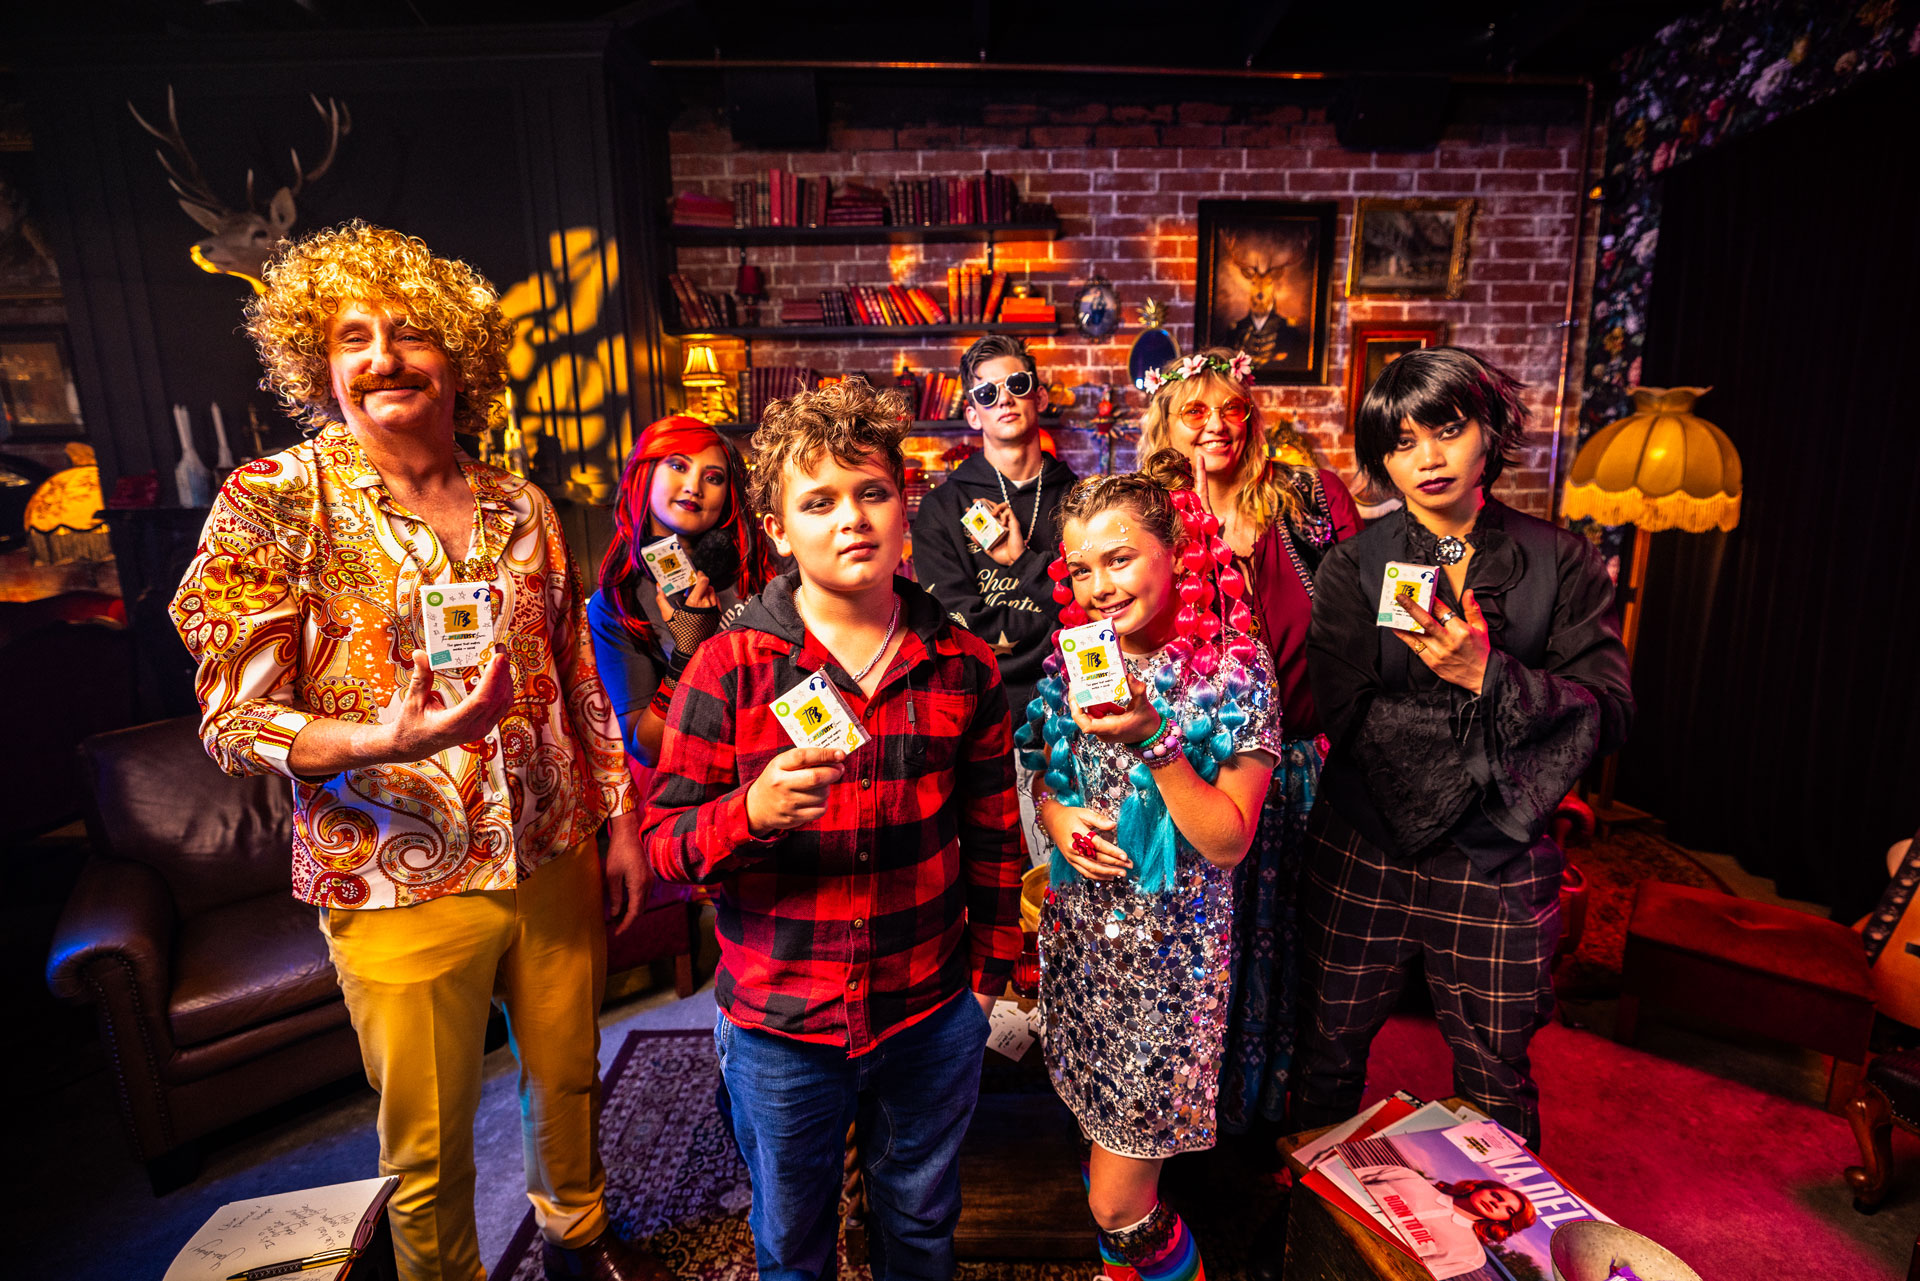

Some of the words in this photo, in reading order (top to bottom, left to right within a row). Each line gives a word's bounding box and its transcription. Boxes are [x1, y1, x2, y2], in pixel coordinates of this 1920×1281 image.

[1383, 1194, 1414, 1219] BORN
[1512, 1181, 1590, 1230] DEL
[1401, 1217, 1424, 1231] TO
[1410, 1229, 1436, 1246] DIE
